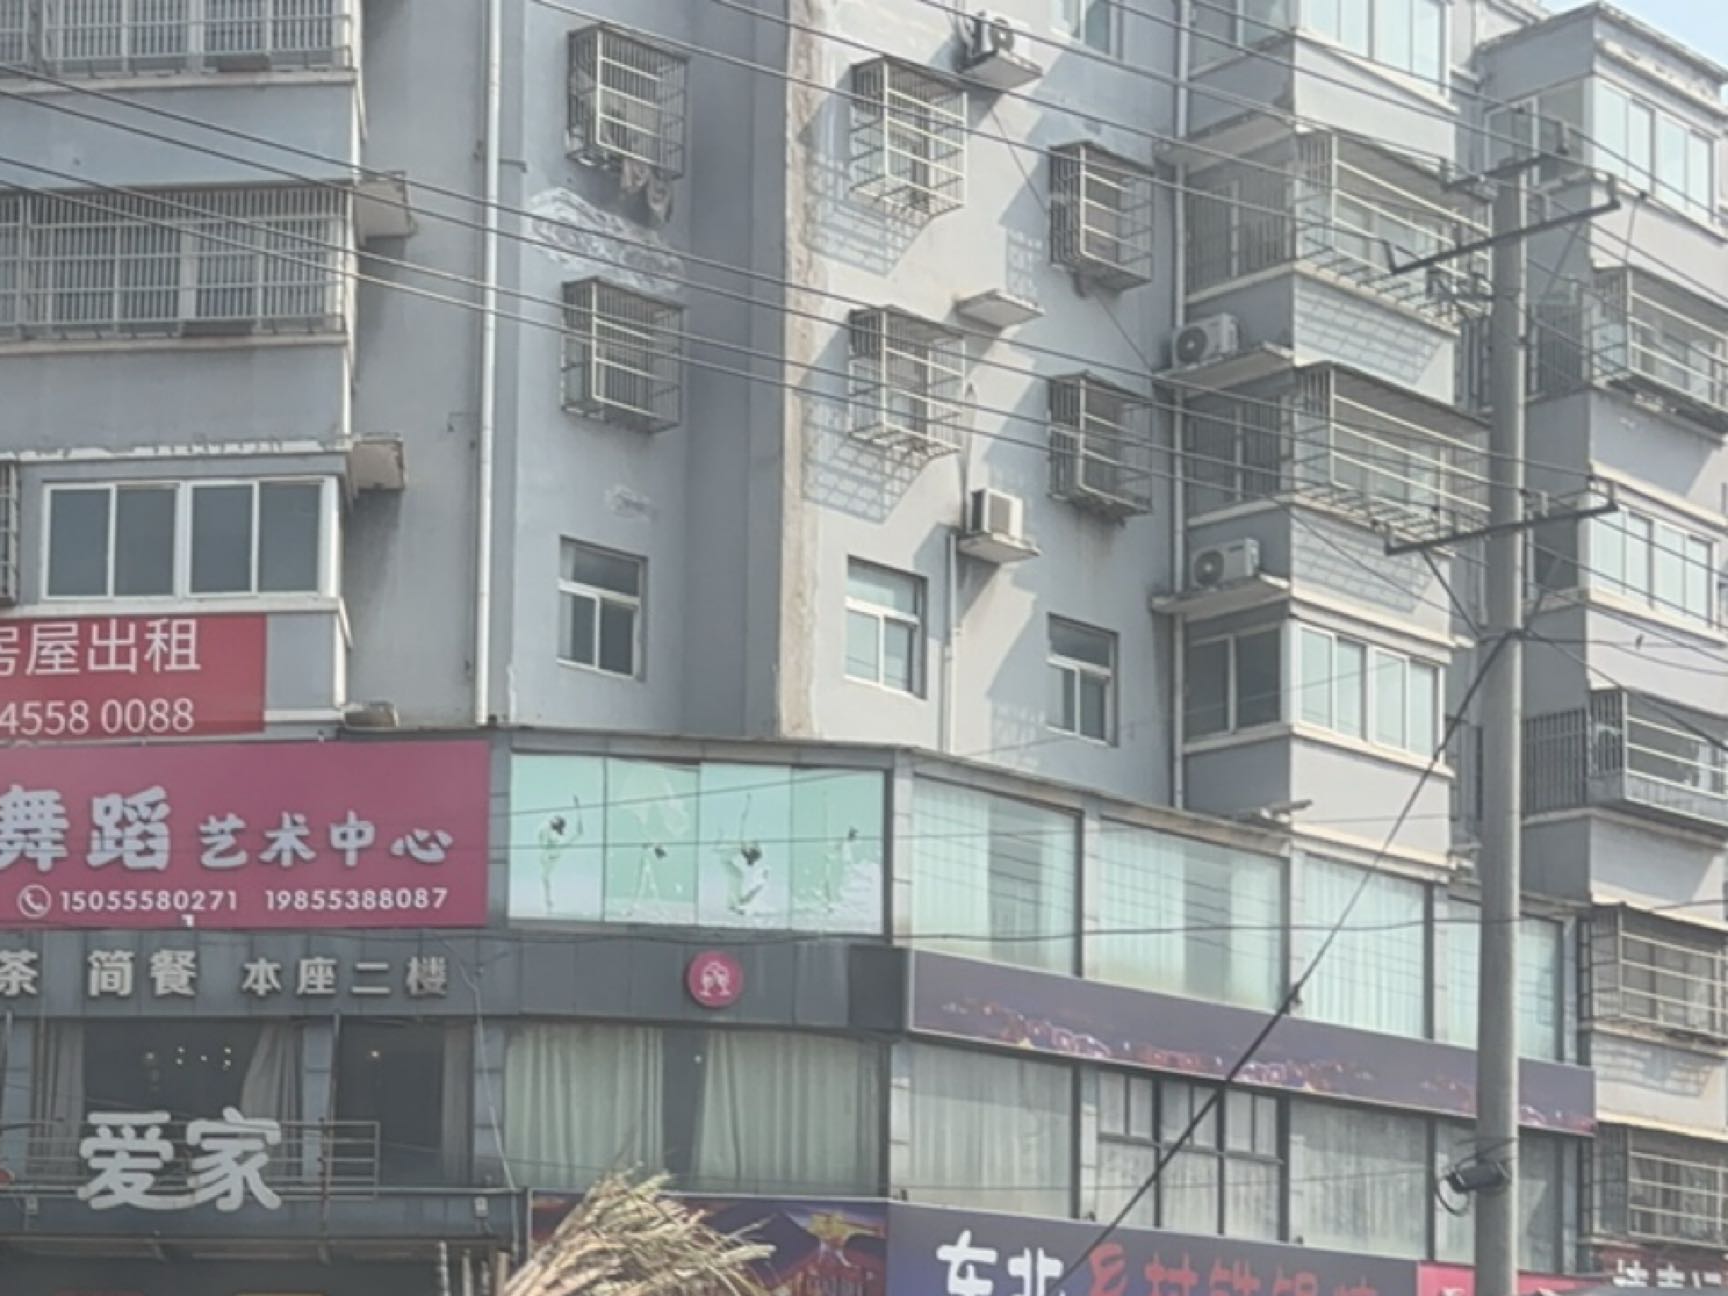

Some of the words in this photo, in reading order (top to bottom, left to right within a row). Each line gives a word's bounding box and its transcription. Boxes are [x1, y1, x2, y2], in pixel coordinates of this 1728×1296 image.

[101, 698, 195, 733] 0088
[196, 811, 454, 868] 艺术中心
[59, 889, 238, 912] 15055580271
[264, 886, 448, 910] 19855388087
[87, 949, 198, 996] 简餐
[242, 957, 449, 996] 本座二楼
[78, 1106, 282, 1211] 爱家
